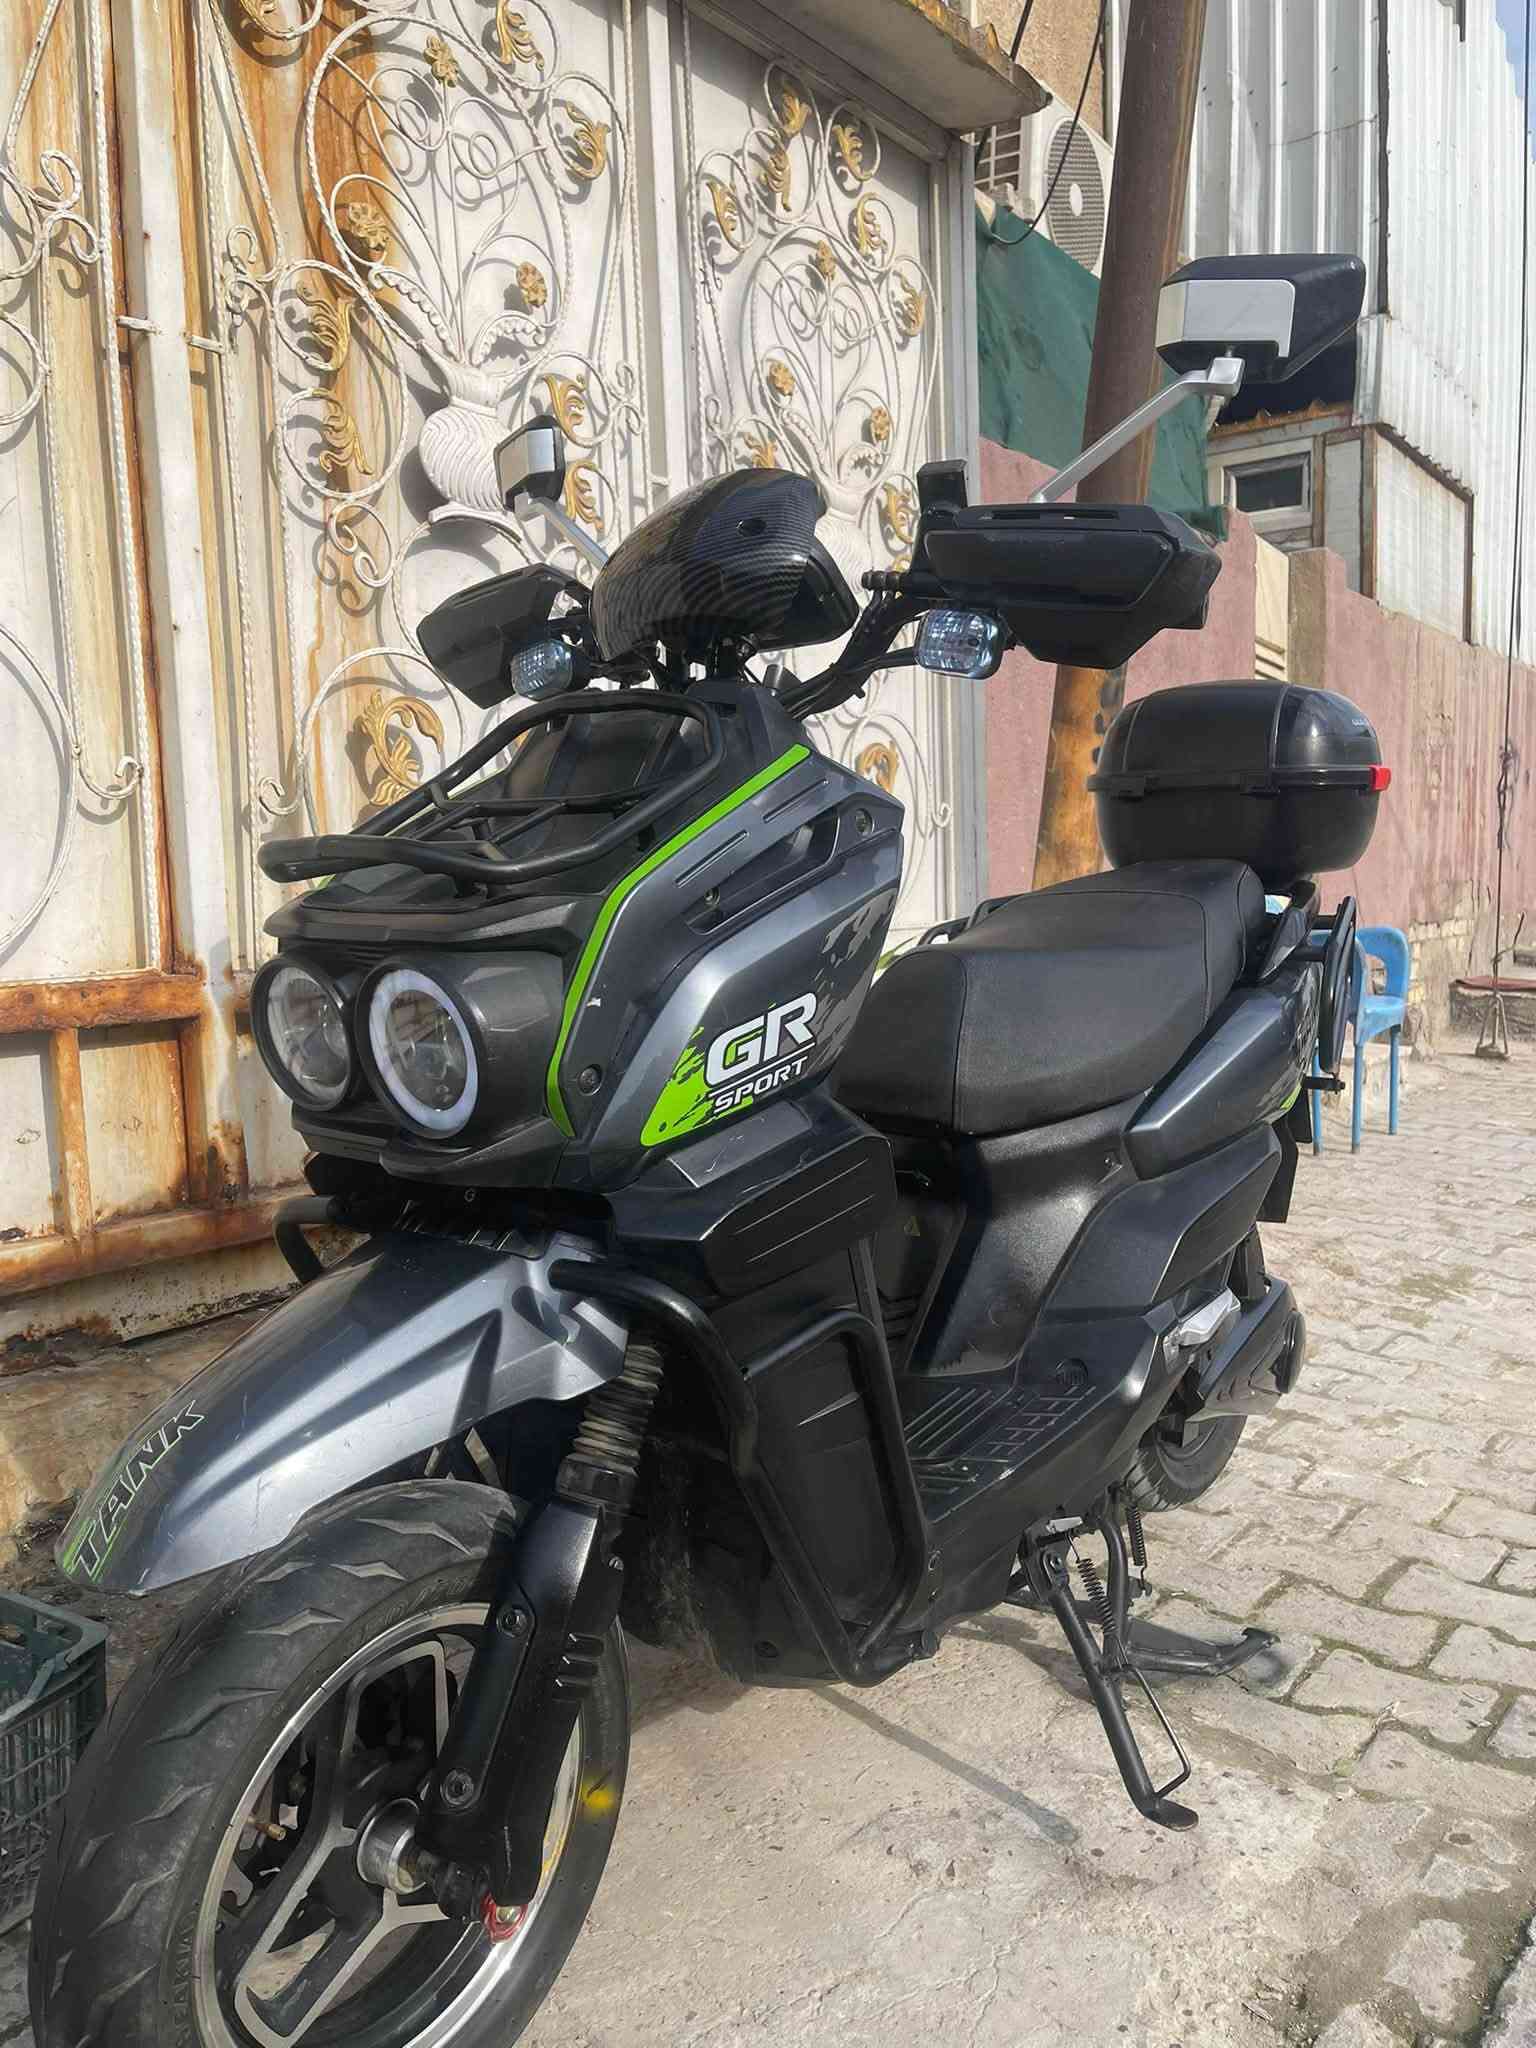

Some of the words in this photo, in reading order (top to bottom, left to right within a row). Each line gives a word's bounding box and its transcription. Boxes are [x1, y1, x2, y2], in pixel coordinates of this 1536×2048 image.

[706, 992, 817, 1086] GR
[713, 1056, 808, 1114] SPORT
[71, 1399, 205, 1577] TANK
